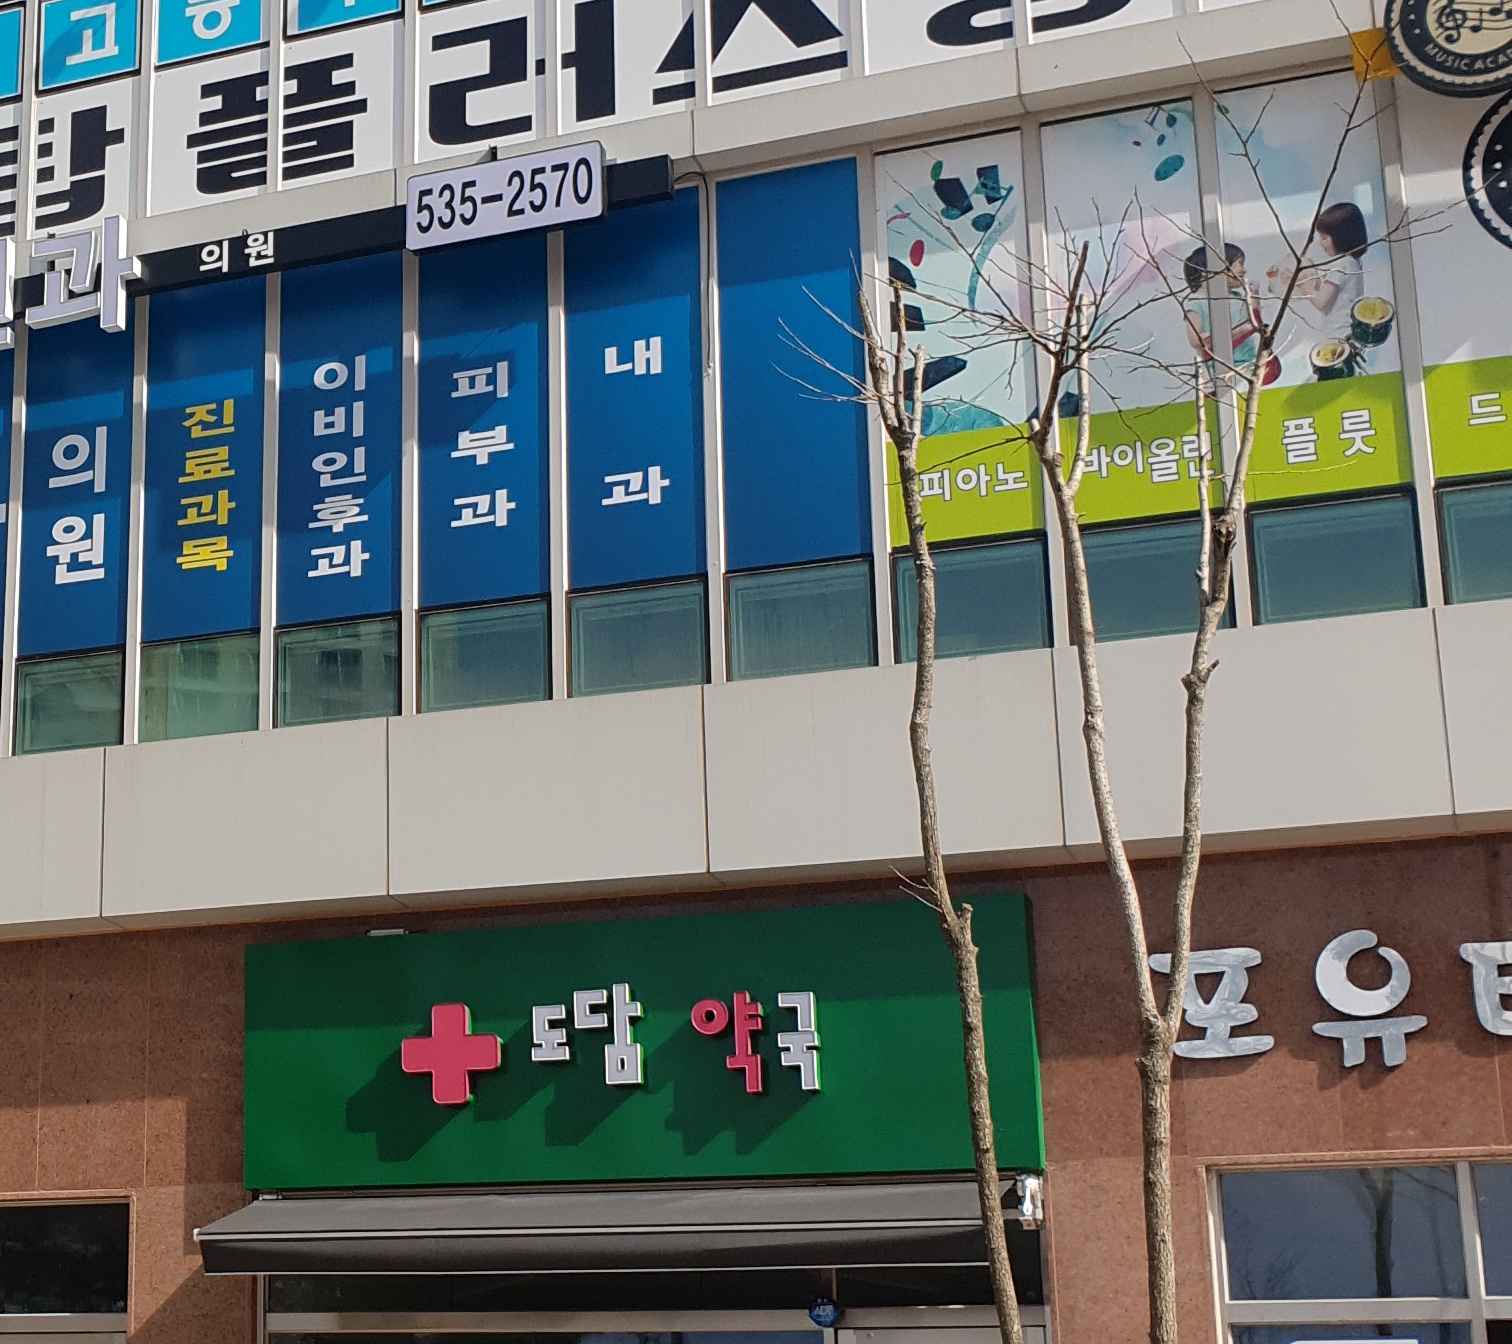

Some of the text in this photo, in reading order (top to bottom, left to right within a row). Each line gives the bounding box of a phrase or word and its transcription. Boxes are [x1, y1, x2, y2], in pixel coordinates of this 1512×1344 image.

[198, 229, 276, 274] 의원
[416, 156, 595, 233] 535-2570
[45, 425, 107, 586] 의원
[175, 398, 236, 573] 진료과목
[307, 353, 370, 579] 이비인후과
[450, 360, 517, 529] 피부과
[918, 462, 1029, 502] 피아노
[530, 982, 822, 1094] 도담 약국
